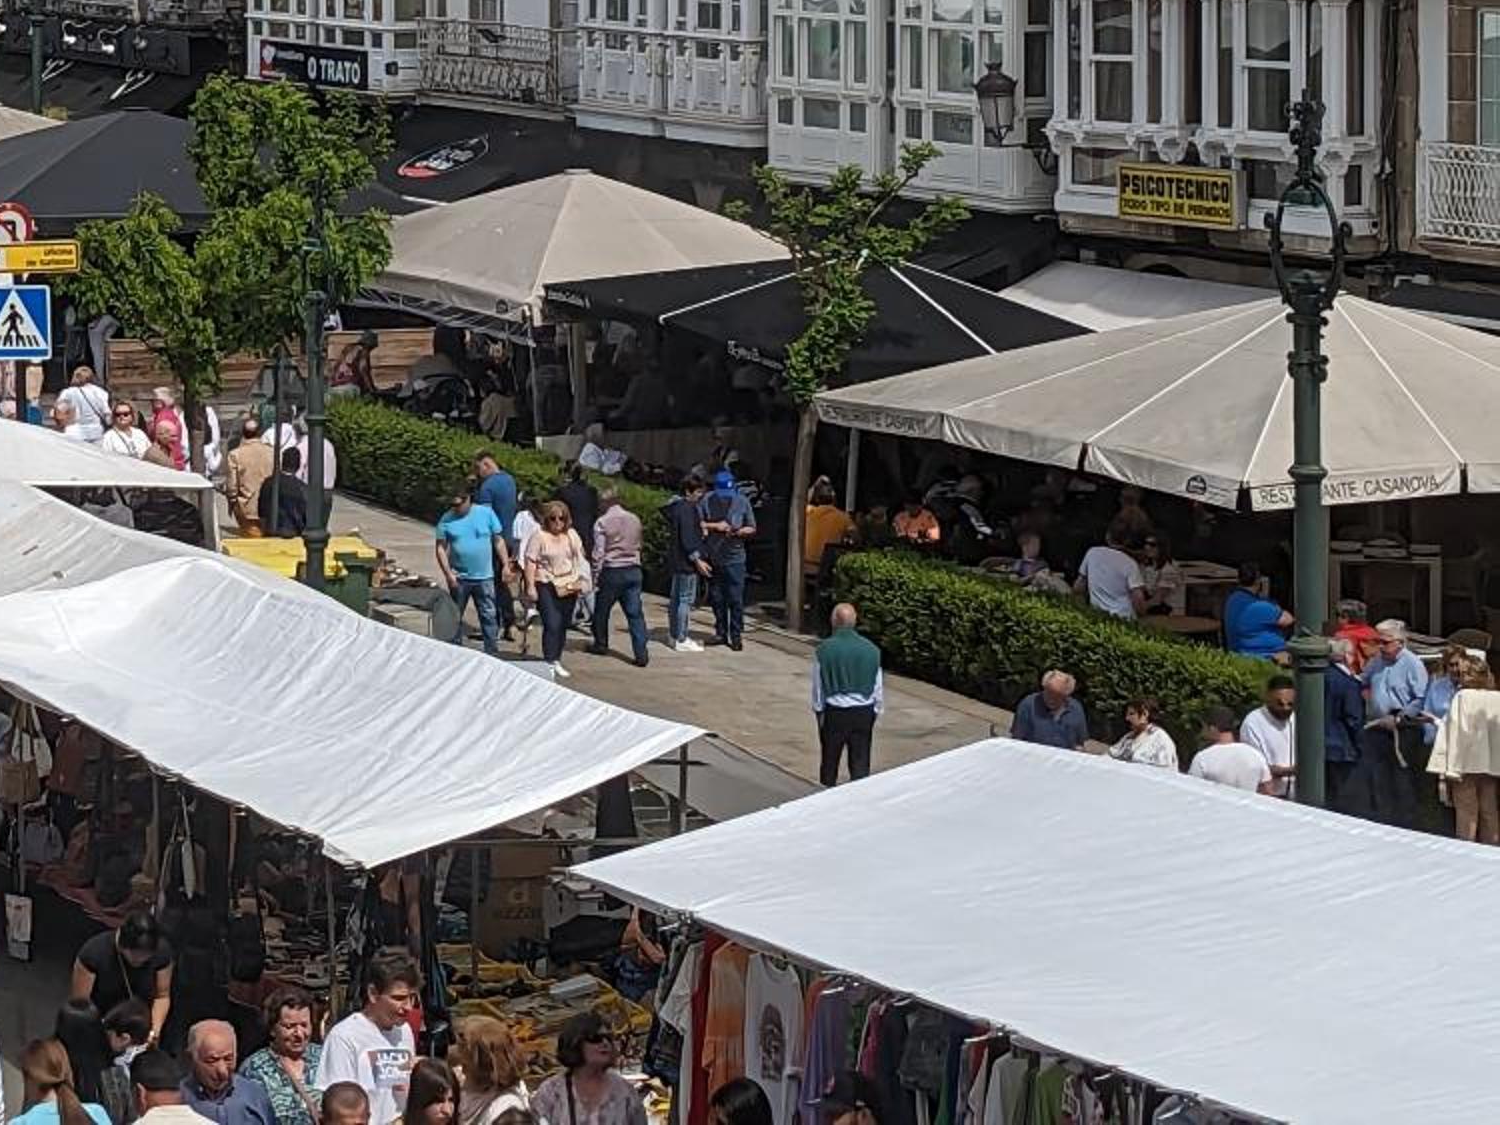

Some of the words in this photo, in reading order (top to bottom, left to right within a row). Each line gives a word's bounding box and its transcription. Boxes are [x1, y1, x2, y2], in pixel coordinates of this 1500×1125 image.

[307, 56, 317, 80] O
[319, 58, 361, 84] TRATO
[1122, 173, 1230, 204] PSICOTECNICO
[1259, 480, 1359, 505] RESANTE
[1362, 473, 1440, 497] CASANOVA
